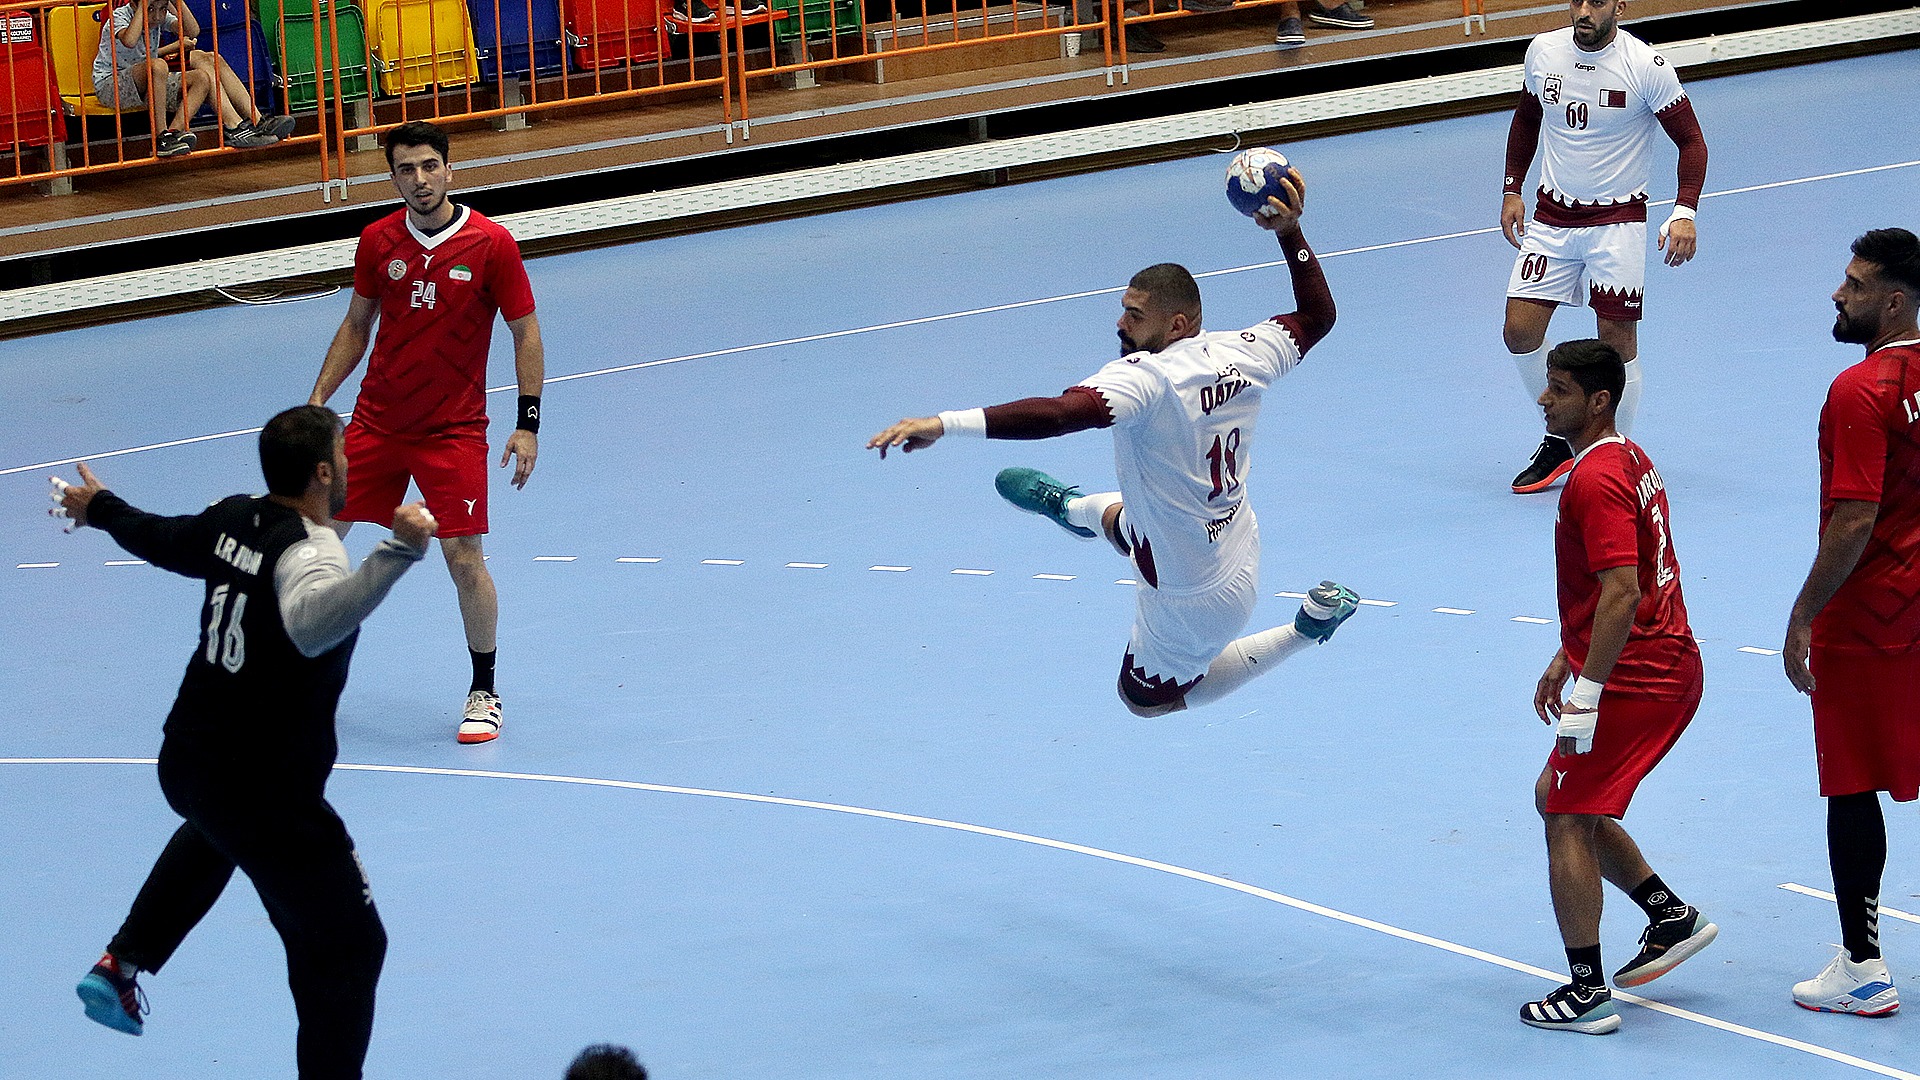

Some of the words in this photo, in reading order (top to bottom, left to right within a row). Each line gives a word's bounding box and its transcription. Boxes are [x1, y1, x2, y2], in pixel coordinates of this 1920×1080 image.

[1575, 62, 1596, 72] Kempa
[1565, 101, 1589, 130] 69
[1521, 252, 1548, 283] 69
[410, 280, 437, 310] 24
[1624, 300, 1641, 309] Kemp
[206, 583, 249, 674] 16
